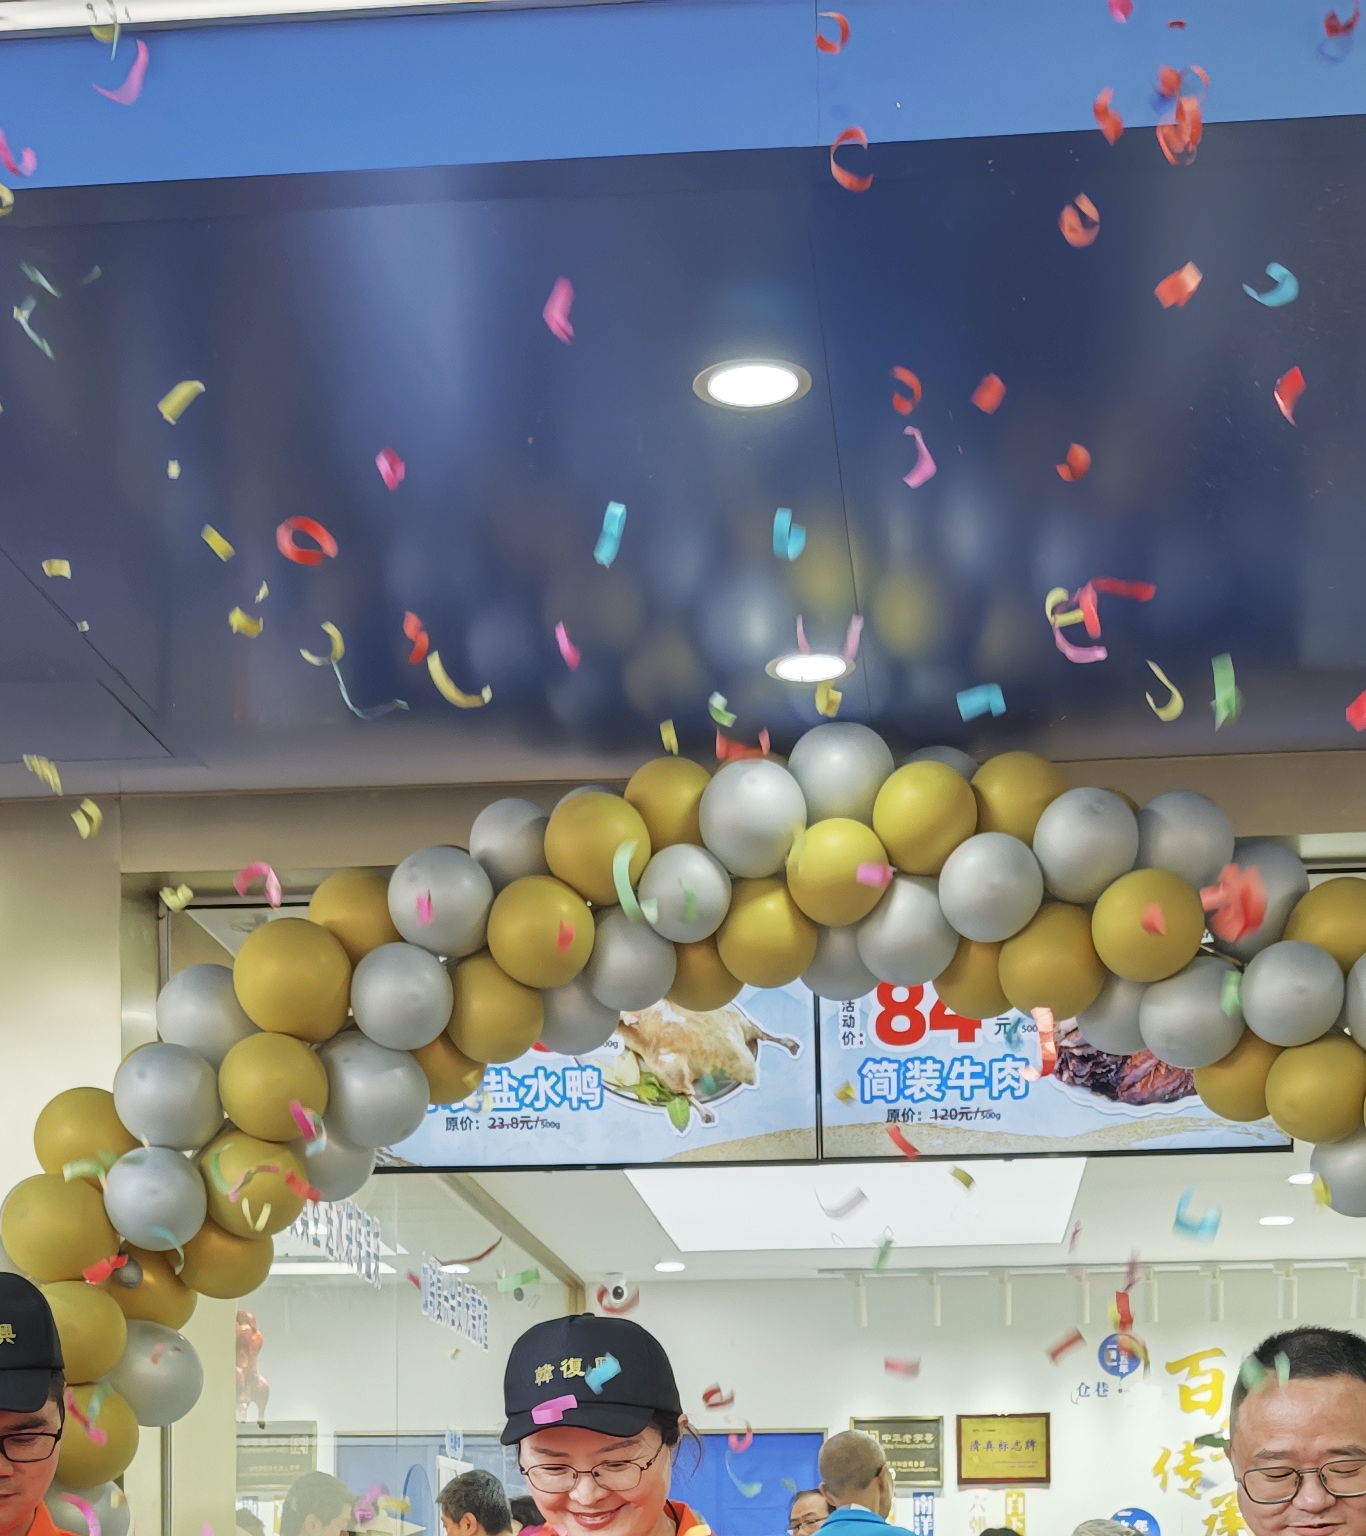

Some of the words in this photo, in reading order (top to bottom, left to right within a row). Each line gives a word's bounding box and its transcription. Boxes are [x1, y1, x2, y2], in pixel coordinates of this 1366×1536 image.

[429, 1067, 603, 1111] 盐水鸭
[860, 1056, 1028, 1103] 简装牛肉
[535, 1356, 609, 1387] 韓復
